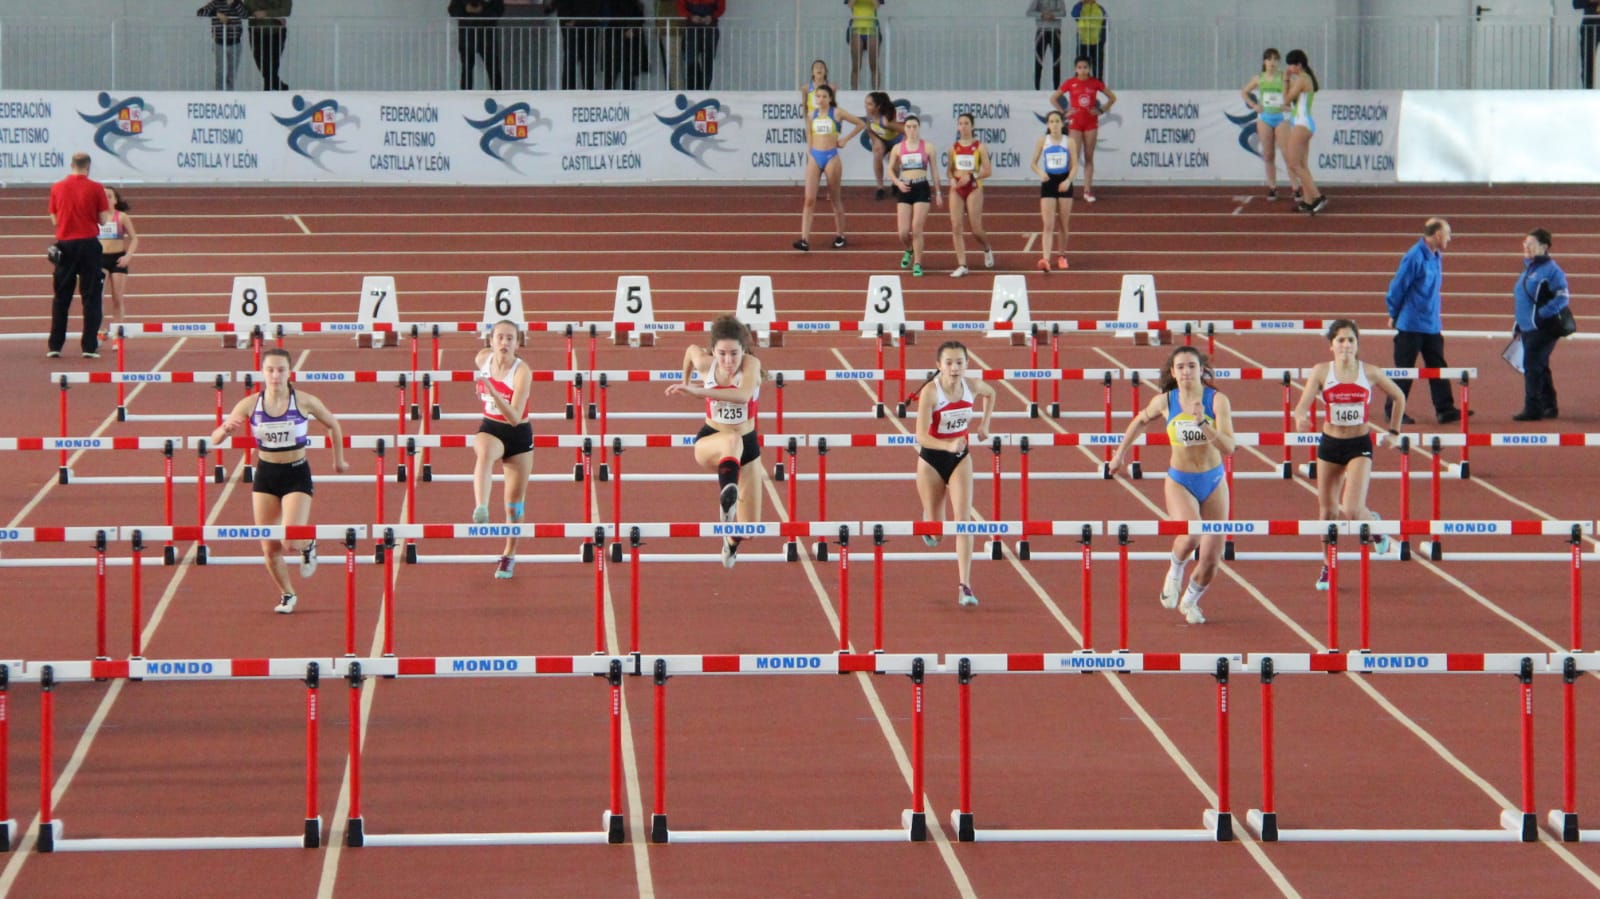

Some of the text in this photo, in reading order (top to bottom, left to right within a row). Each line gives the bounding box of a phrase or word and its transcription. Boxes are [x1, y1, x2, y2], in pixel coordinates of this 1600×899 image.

[0, 98, 52, 119] EDERACIÓN
[187, 99, 246, 120] FEDERACIÓN
[380, 102, 439, 123] FEDERACIÓN
[572, 102, 630, 123] FEDERACIÓN
[762, 103, 804, 120] FEDERAC
[1142, 100, 1200, 120] FEDERACIÓN
[1332, 102, 1388, 121] FEDERACIÓN
[191, 128, 244, 144] ATLETISMO
[383, 131, 436, 148] ATLETISMO
[575, 131, 628, 147] ATLETISMO
[1144, 127, 1196, 144] ATLETISMO
[1332, 129, 1384, 146] ATLETISMO
[30, 152, 37, 168] Y
[39, 148, 64, 168] LEÓN
[177, 149, 258, 169] CASTILLA Y LEÓN
[370, 152, 450, 172] CASTILLA Y LEÓN
[561, 150, 642, 171] CASTILLA Y LEÓN
[752, 152, 797, 168] CASTILLA
[797, 152, 804, 167] Y
[996, 149, 1021, 168] LEÓN
[1130, 149, 1209, 168] CASTILLA Y LEÓN
[1319, 151, 1395, 172] CASTILLA Y LEÓN
[242, 288, 258, 317] 8
[370, 290, 387, 319] 7
[494, 288, 512, 316] 6
[626, 286, 643, 315] 5
[746, 286, 763, 315] 4
[874, 285, 893, 314] 3
[1133, 284, 1145, 313] 1
[1002, 299, 1018, 321] 2
[330, 323, 365, 331] MONDO
[796, 322, 831, 330] MONDO
[1260, 321, 1295, 329] MONDO
[122, 373, 162, 381] MONDO
[306, 372, 345, 381] MONDO
[660, 371, 698, 379] MONO
[835, 371, 874, 379] MONDO
[1014, 370, 1052, 378] MONDO
[1386, 369, 1408, 377] NDO
[718, 407, 743, 420] 1235
[1336, 409, 1359, 422] 1460
[55, 439, 101, 447] MONDO
[264, 431, 289, 443] 3977
[888, 435, 914, 444] MON
[1090, 435, 1124, 443] MOND
[1182, 430, 1207, 442] 3006
[1297, 435, 1321, 443] MON
[1502, 435, 1548, 444] MONDO
[217, 527, 272, 538] MONDO
[468, 524, 522, 536] MONDO
[712, 523, 767, 535] MONDO
[955, 522, 1009, 534] MONDO
[1201, 522, 1255, 534] MONDO
[1443, 522, 1497, 534] MONDO
[147, 662, 214, 676] MONDO
[452, 658, 519, 672] MONDO
[756, 655, 823, 670] MONDO
[1363, 655, 1430, 671] MONDO
